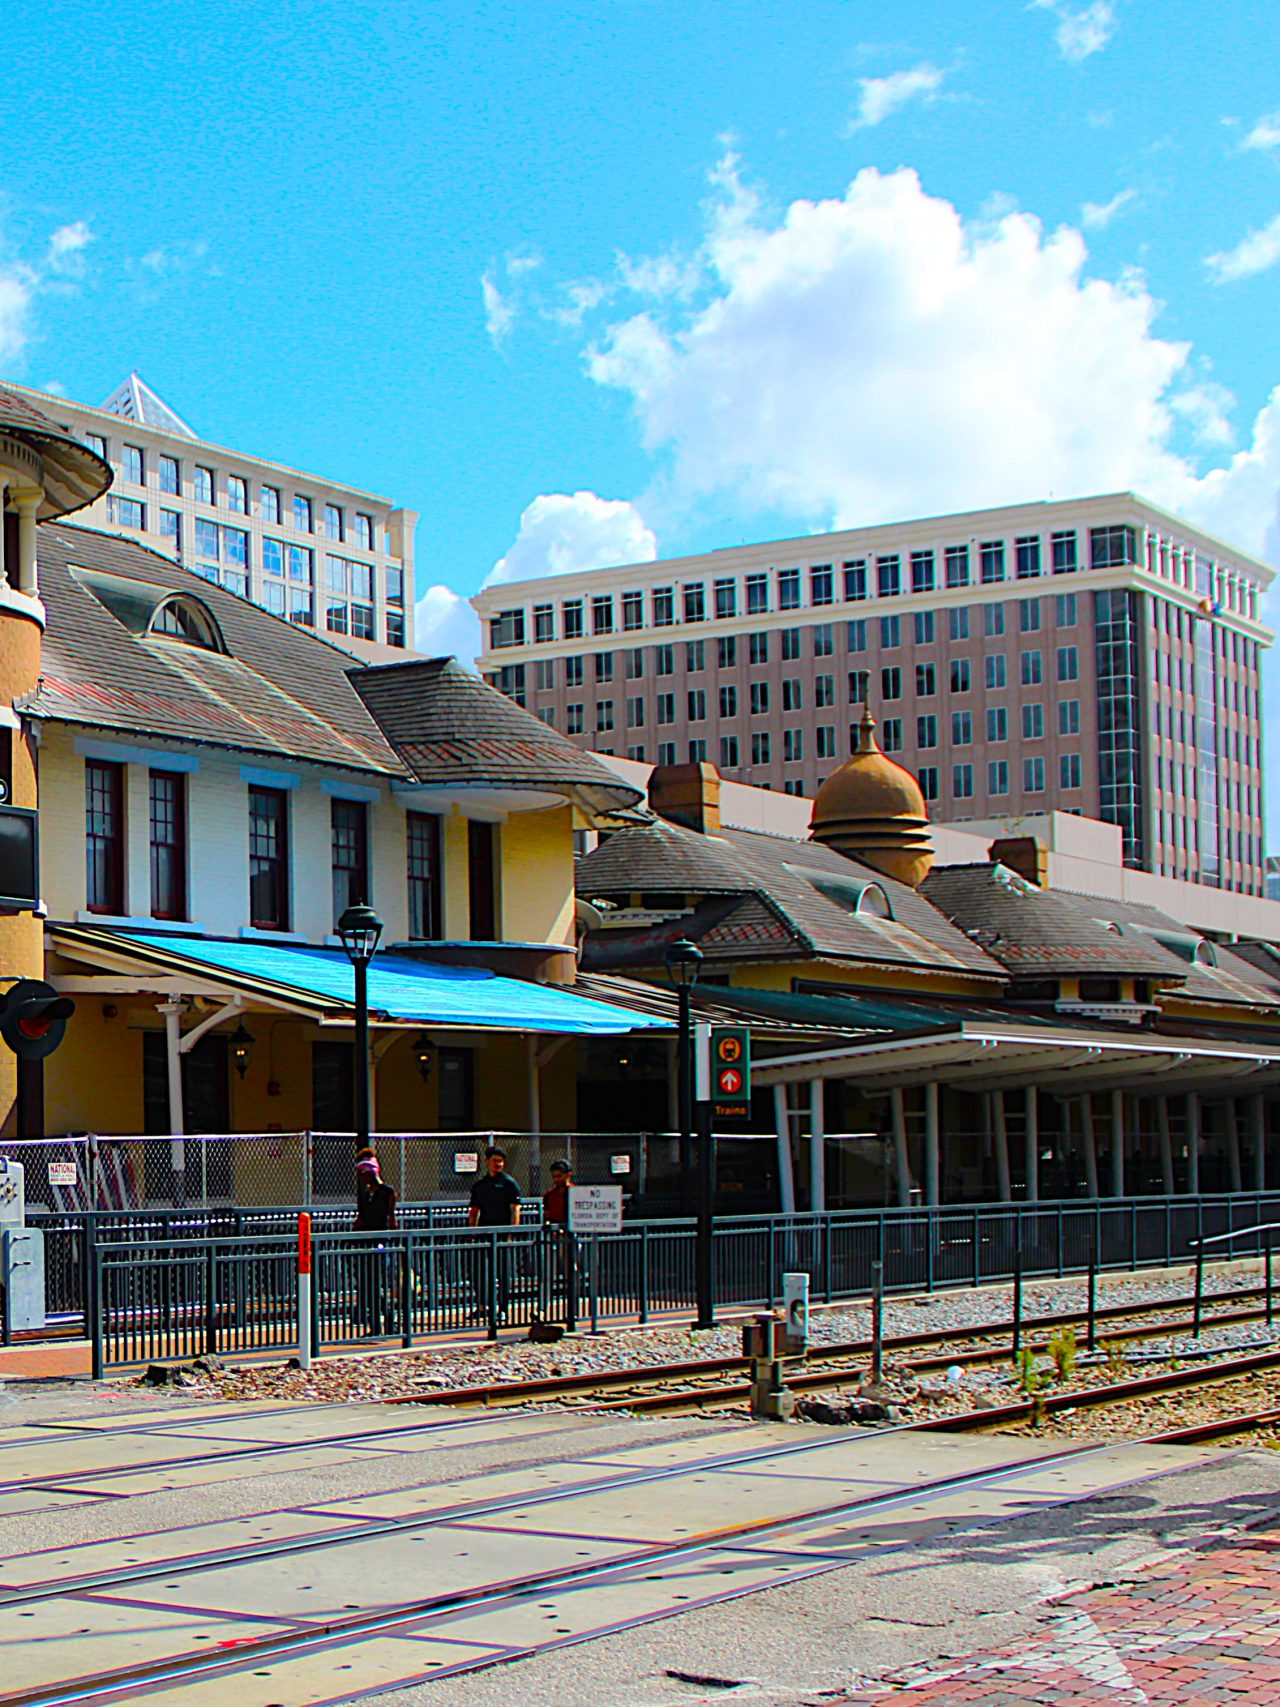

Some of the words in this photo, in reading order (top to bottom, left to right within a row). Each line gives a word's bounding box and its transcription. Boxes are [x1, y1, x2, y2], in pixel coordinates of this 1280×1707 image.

[715, 1106, 748, 1116] Trains
[51, 1164, 75, 1173] NATIONAL
[590, 1189, 600, 1198] NO
[575, 1201, 616, 1210] TRESPASSING
